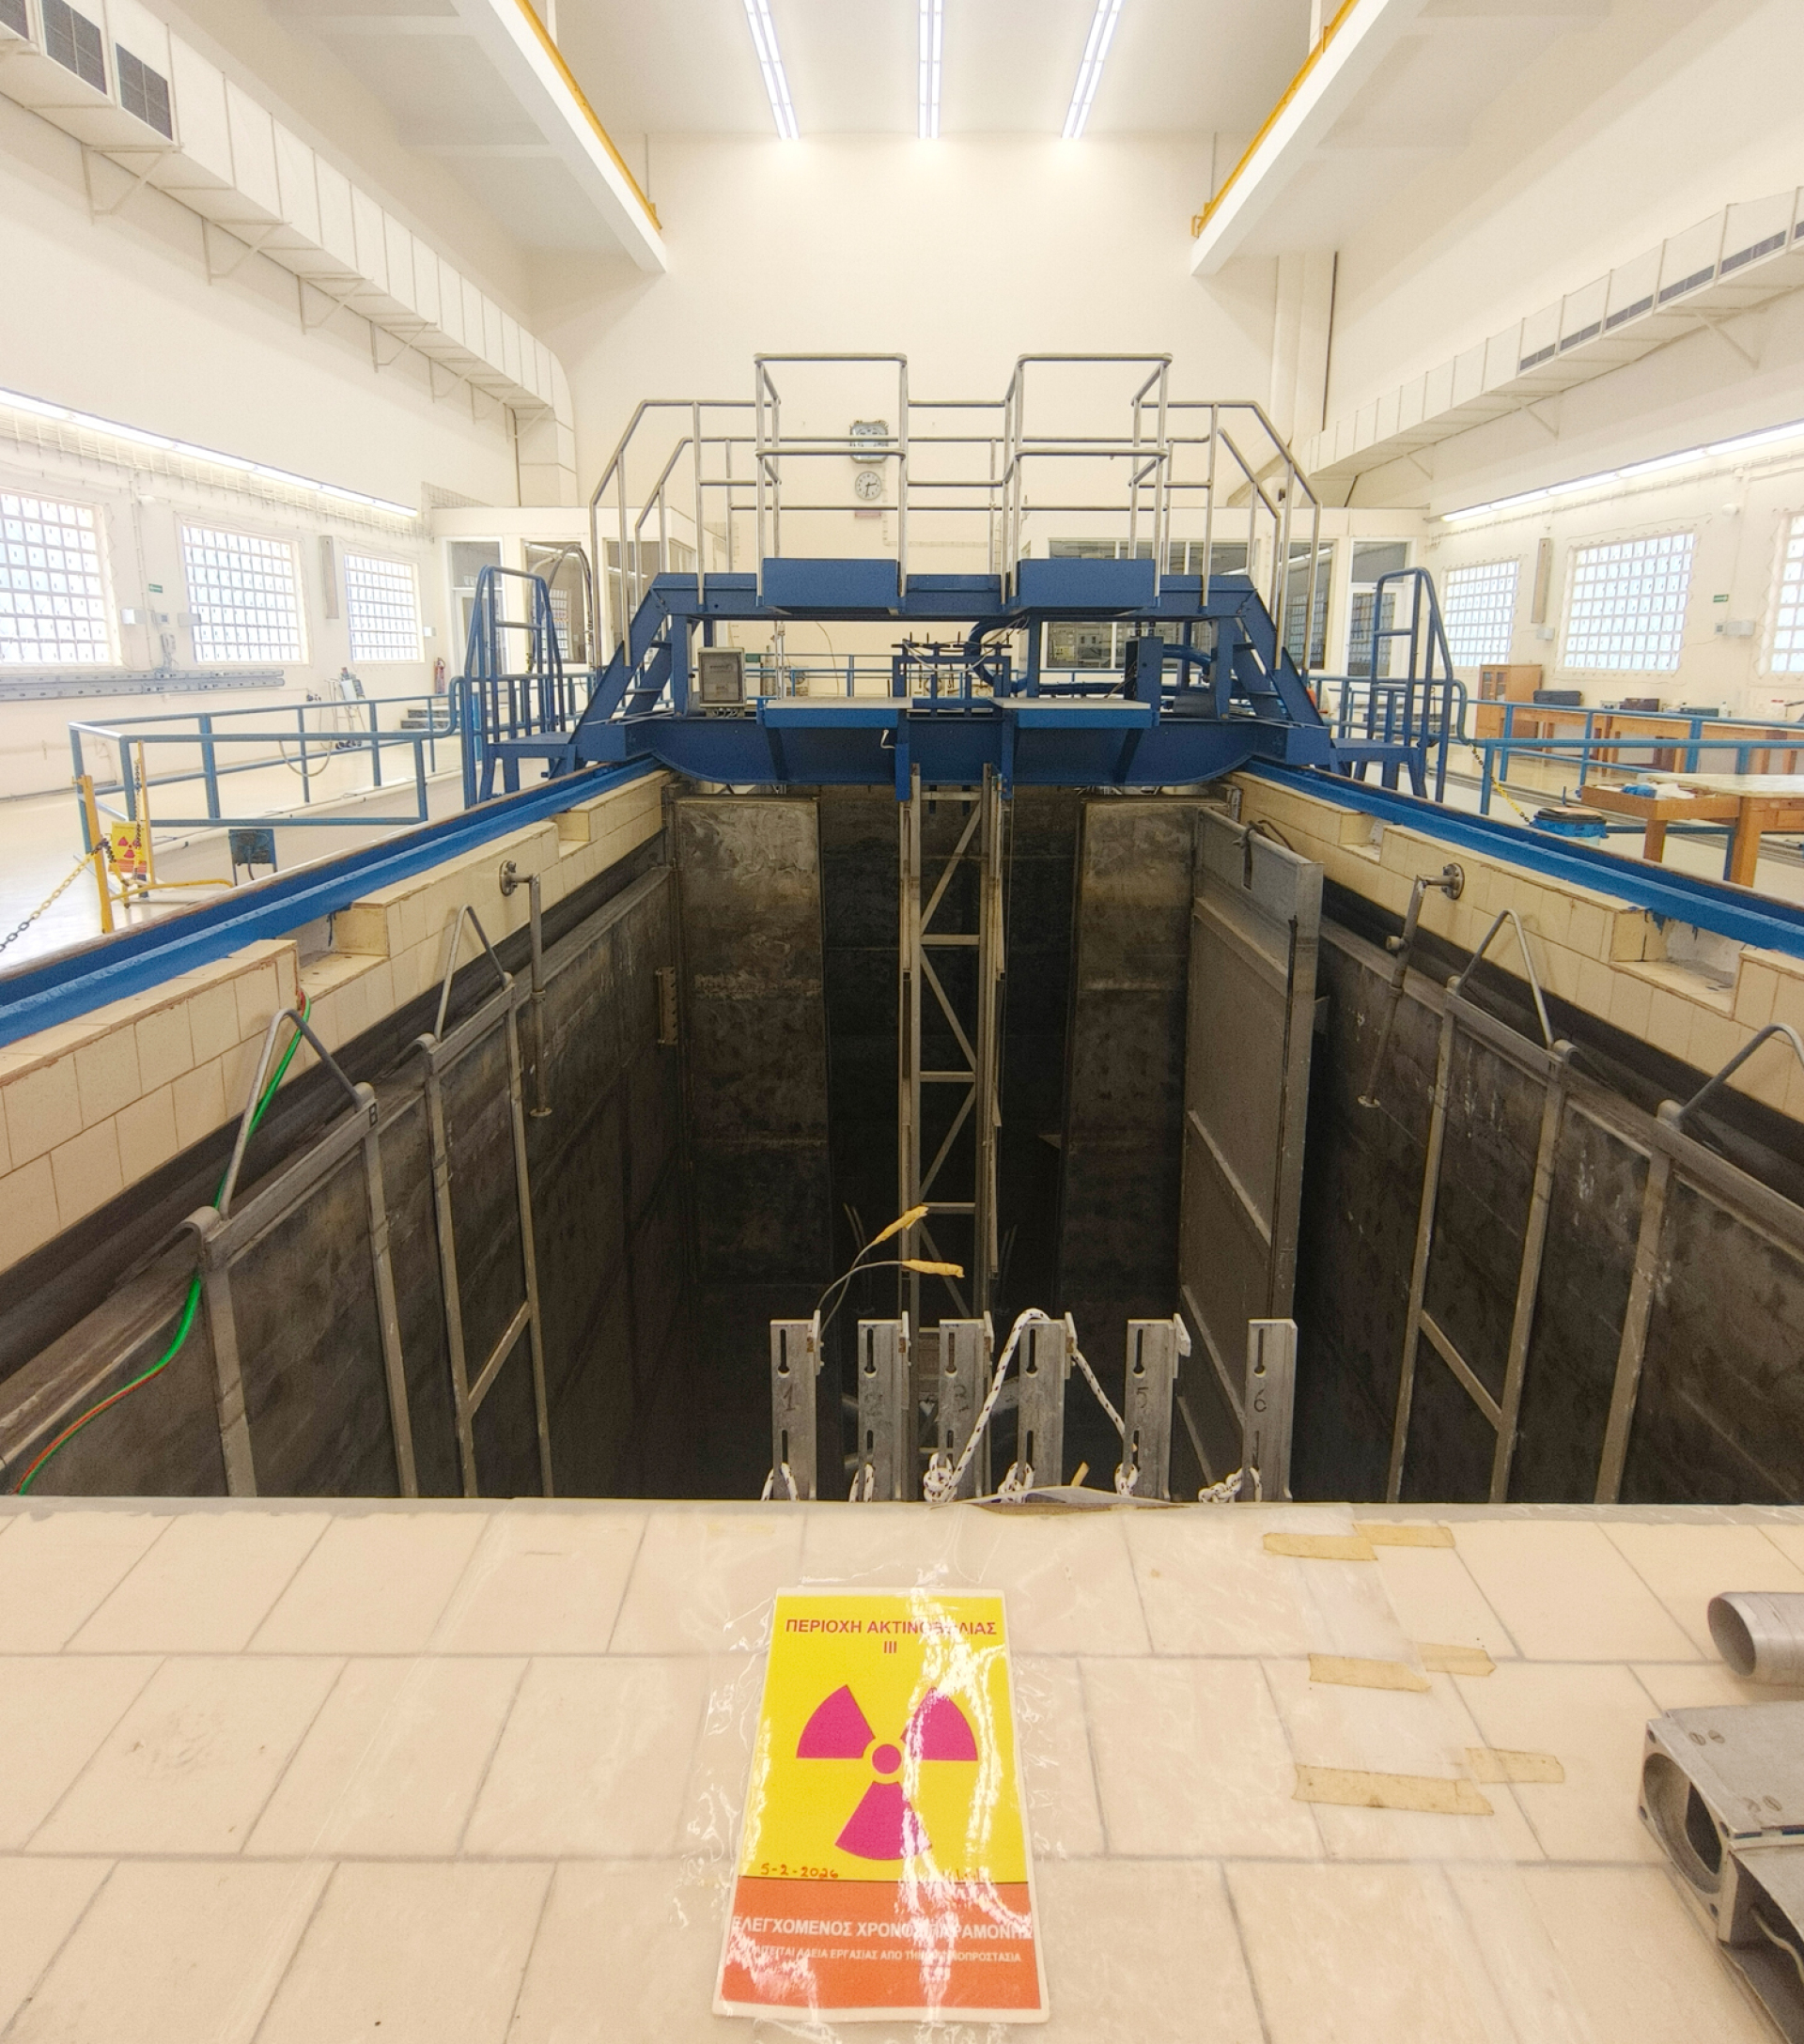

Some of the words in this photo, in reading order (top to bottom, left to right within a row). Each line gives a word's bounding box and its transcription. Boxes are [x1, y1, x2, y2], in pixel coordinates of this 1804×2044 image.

[783, 1384, 796, 1412] 1
[1136, 1386, 1149, 1409] 5
[1253, 1388, 1267, 1413] 6
[785, 1618, 862, 1634] ΠΕΡΙΟΧΗ
[883, 1641, 897, 1654] III
[760, 1863, 839, 1879] 5-2-2026
[733, 1914, 852, 1936] ΕΛΕΓΧΟΜΕΝΟΣ
[830, 1949, 878, 1960] ΕΡΓΑΣΙΑΣ
[880, 1950, 902, 1960] ΑΠΟ
[906, 1950, 925, 1961] ΤΗ
